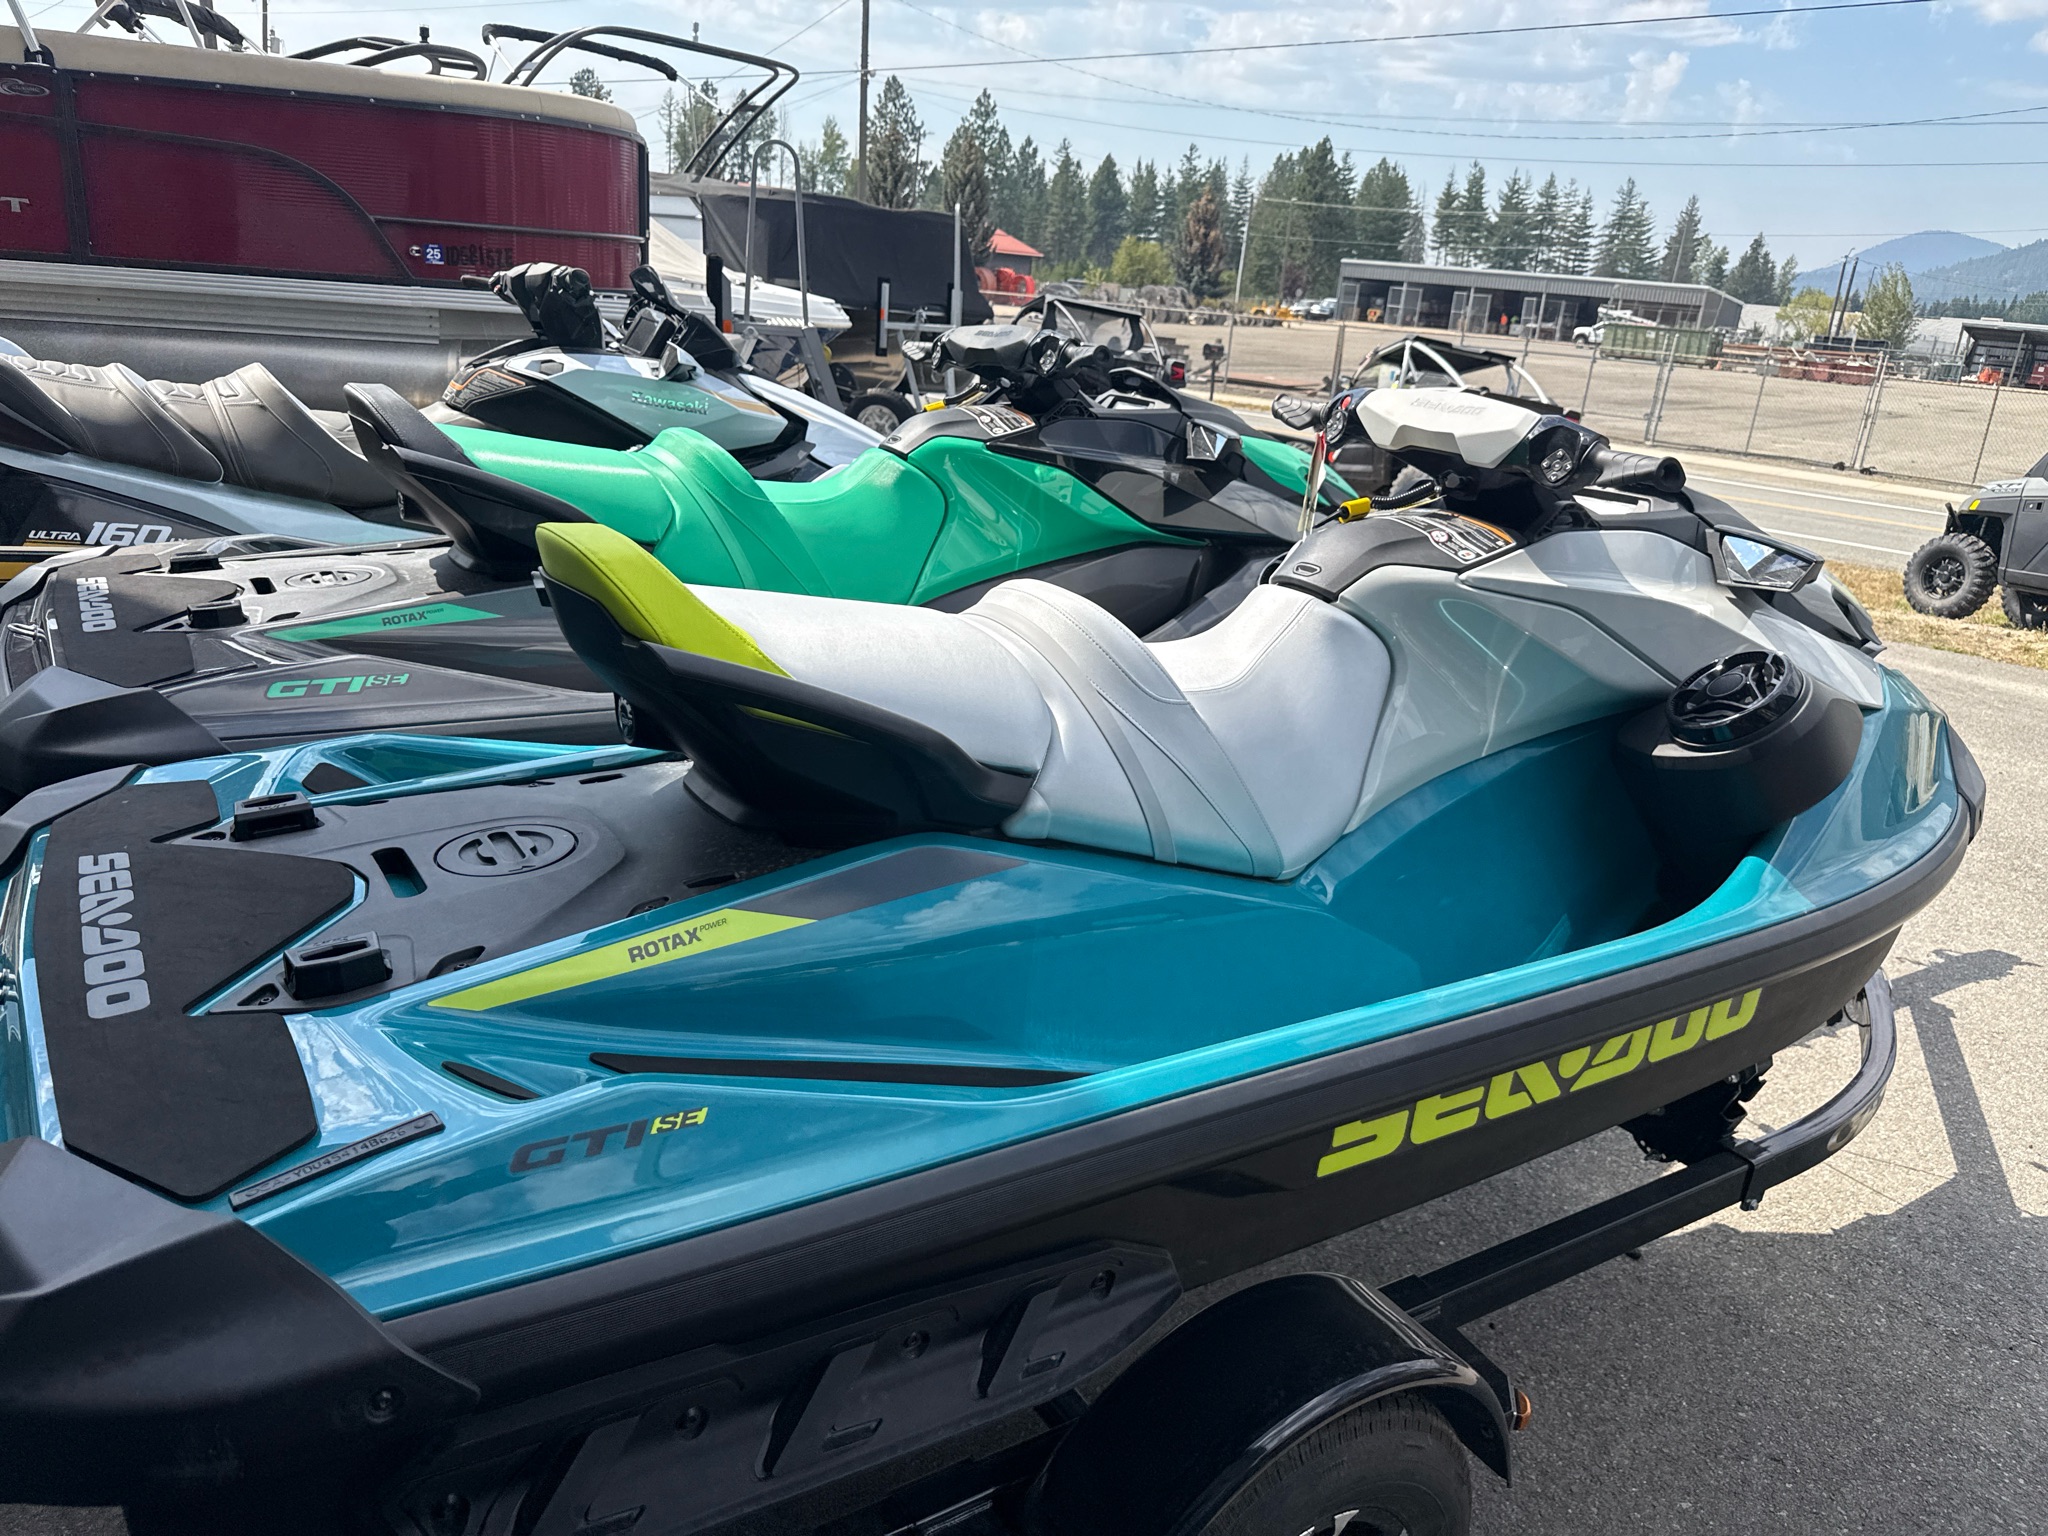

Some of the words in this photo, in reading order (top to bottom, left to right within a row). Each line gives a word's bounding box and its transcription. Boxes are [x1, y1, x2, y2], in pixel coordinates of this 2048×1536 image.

[425, 248, 442, 260] 25
[631, 391, 709, 415] Kawasaki
[28, 530, 82, 541] ULTRA
[84, 521, 173, 547] 160
[381, 611, 428, 627] ROTAX
[426, 607, 445, 615] POWER
[266, 676, 367, 699] GTI
[366, 673, 410, 687] SE
[627, 927, 702, 964] ROTAX
[699, 917, 728, 933] POWER
[510, 1118, 649, 1173] GTI
[649, 1107, 709, 1135] SE
